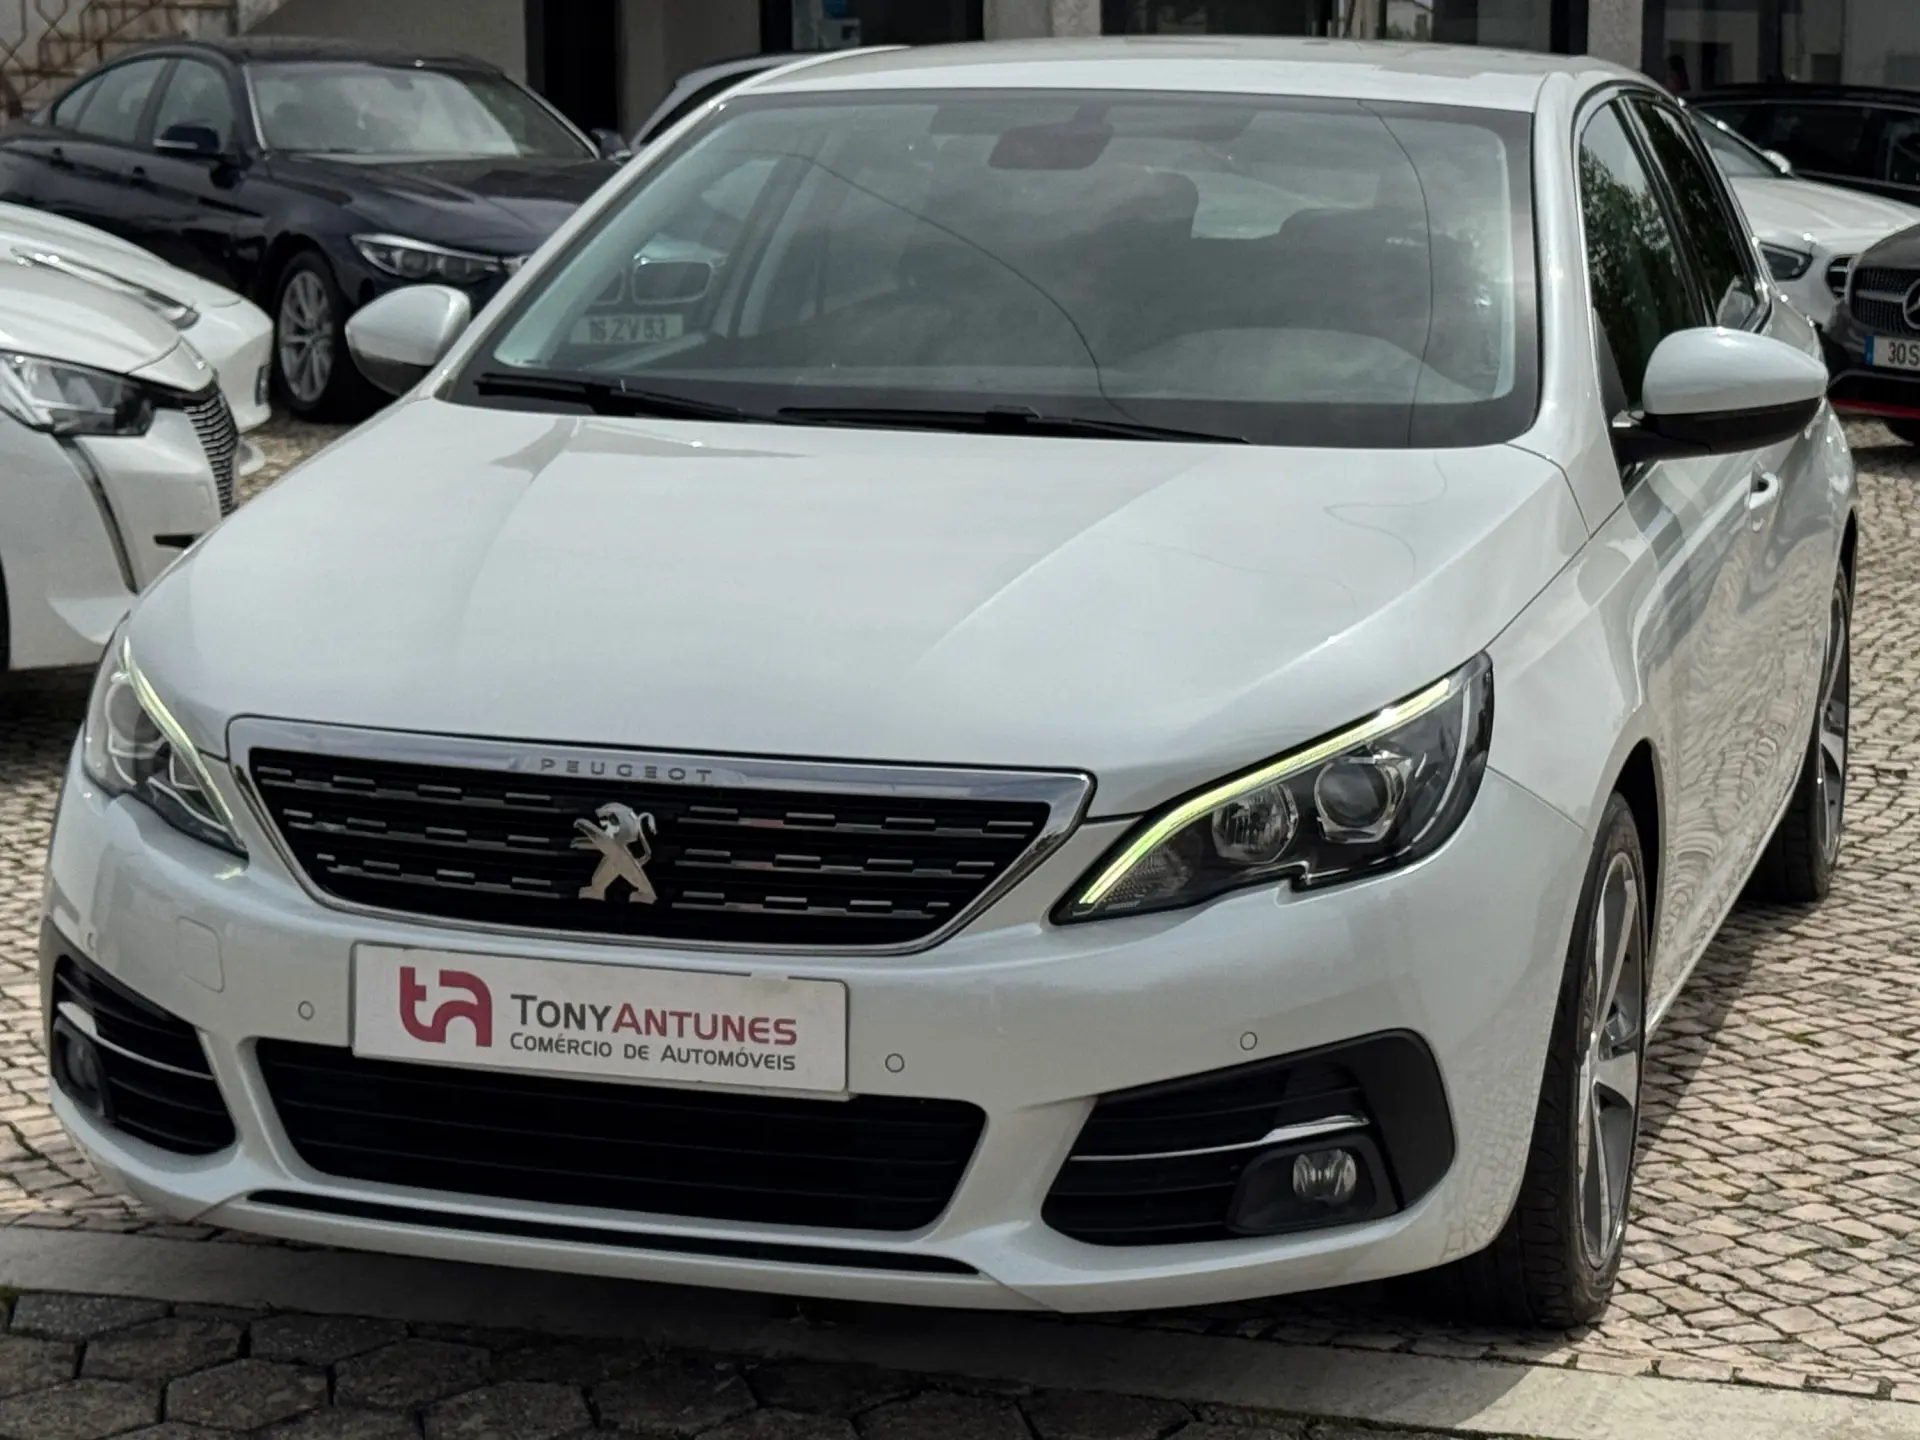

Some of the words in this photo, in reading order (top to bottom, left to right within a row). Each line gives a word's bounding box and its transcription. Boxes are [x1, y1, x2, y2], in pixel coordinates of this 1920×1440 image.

[541, 758, 712, 782] PEUGEOT
[510, 1032, 612, 1058] COMÉRCIO
[623, 1043, 650, 1061] DE
[660, 1044, 796, 1071] AUTOMÓVEIS
